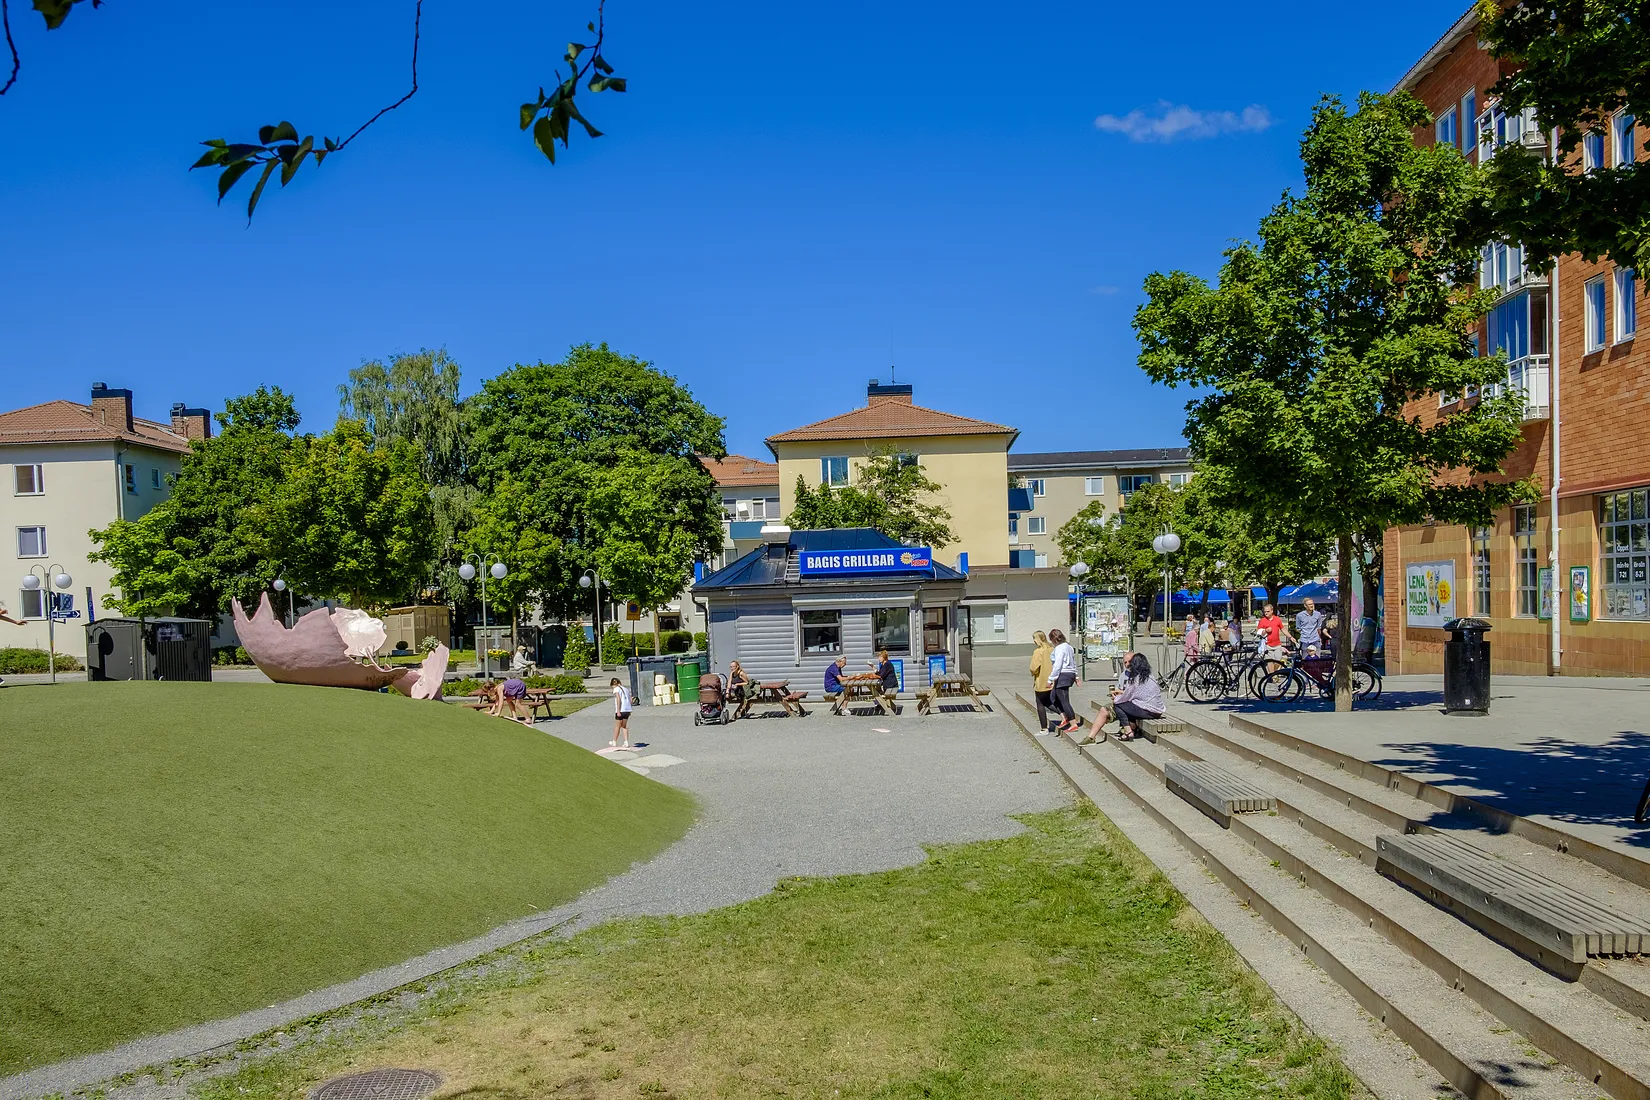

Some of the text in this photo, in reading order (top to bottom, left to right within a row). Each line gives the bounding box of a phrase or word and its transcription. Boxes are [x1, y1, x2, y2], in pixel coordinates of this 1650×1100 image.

[807, 556, 840, 568] BAGIS
[843, 554, 894, 567] GRILLBAR
[1409, 592, 1428, 604] MILDA
